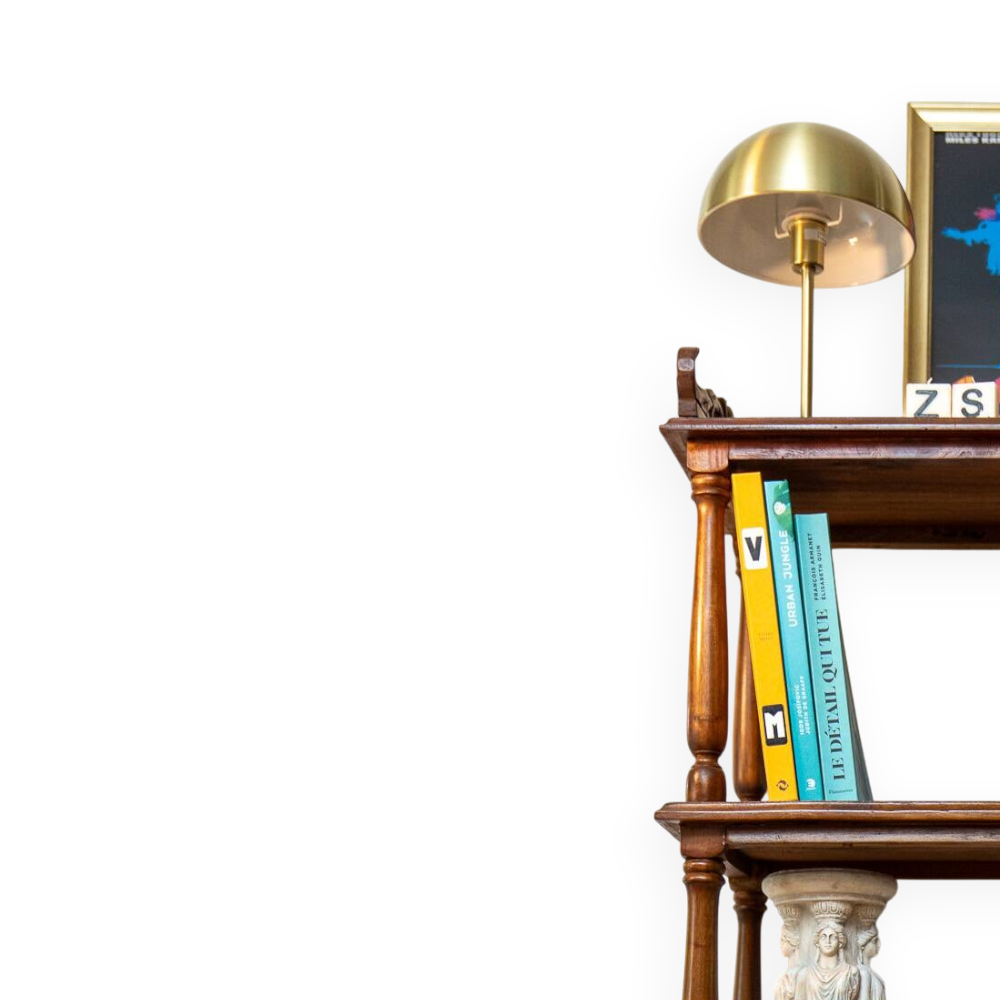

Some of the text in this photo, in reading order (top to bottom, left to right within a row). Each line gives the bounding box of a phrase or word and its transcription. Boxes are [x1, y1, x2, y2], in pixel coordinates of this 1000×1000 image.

[914, 389, 940, 418] Z
[960, 389, 984, 418] S
[744, 536, 763, 562] V
[779, 530, 798, 628] URBAN JUNGLE
[816, 609, 846, 780] LE DÉTAIL QUI TUE
